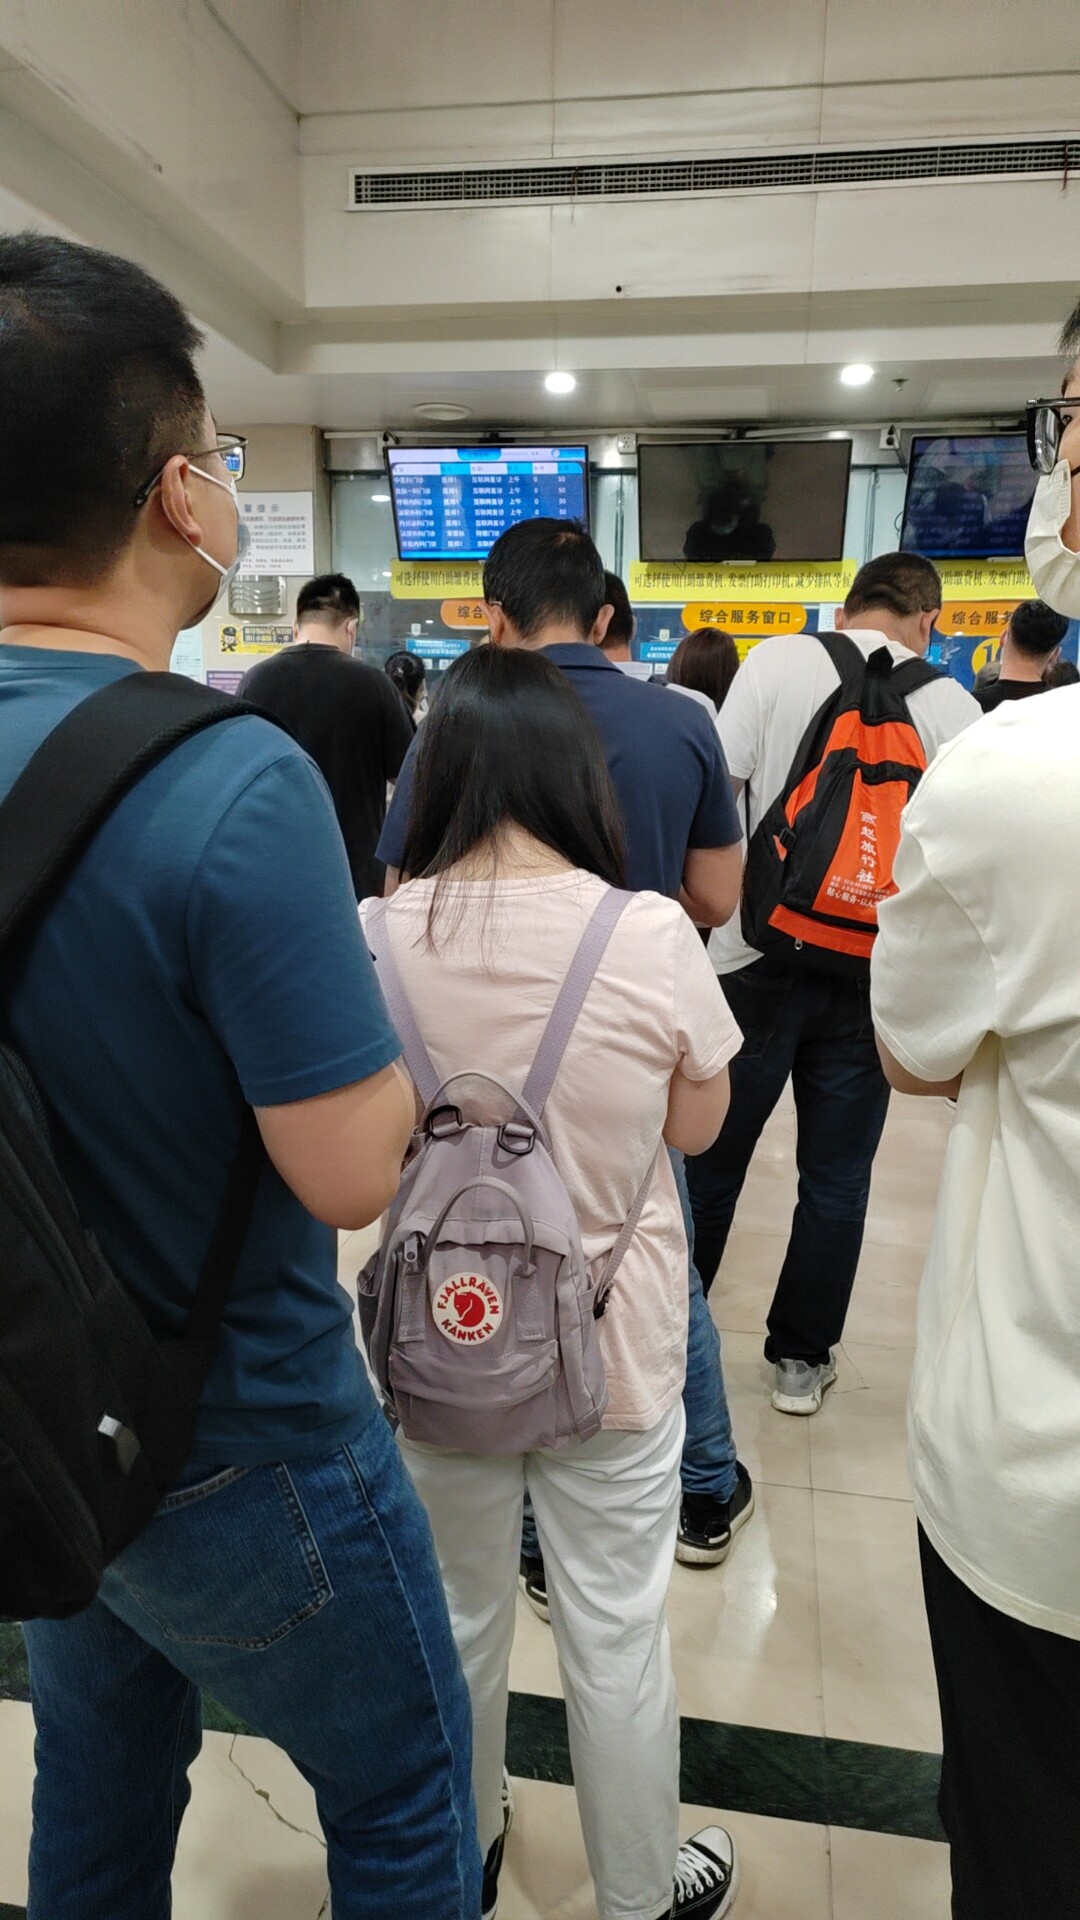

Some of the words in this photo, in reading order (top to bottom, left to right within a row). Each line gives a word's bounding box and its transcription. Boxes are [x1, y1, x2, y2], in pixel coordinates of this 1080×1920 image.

[457, 605, 483, 619] 综合
[699, 609, 790, 624] 综合服务窗口
